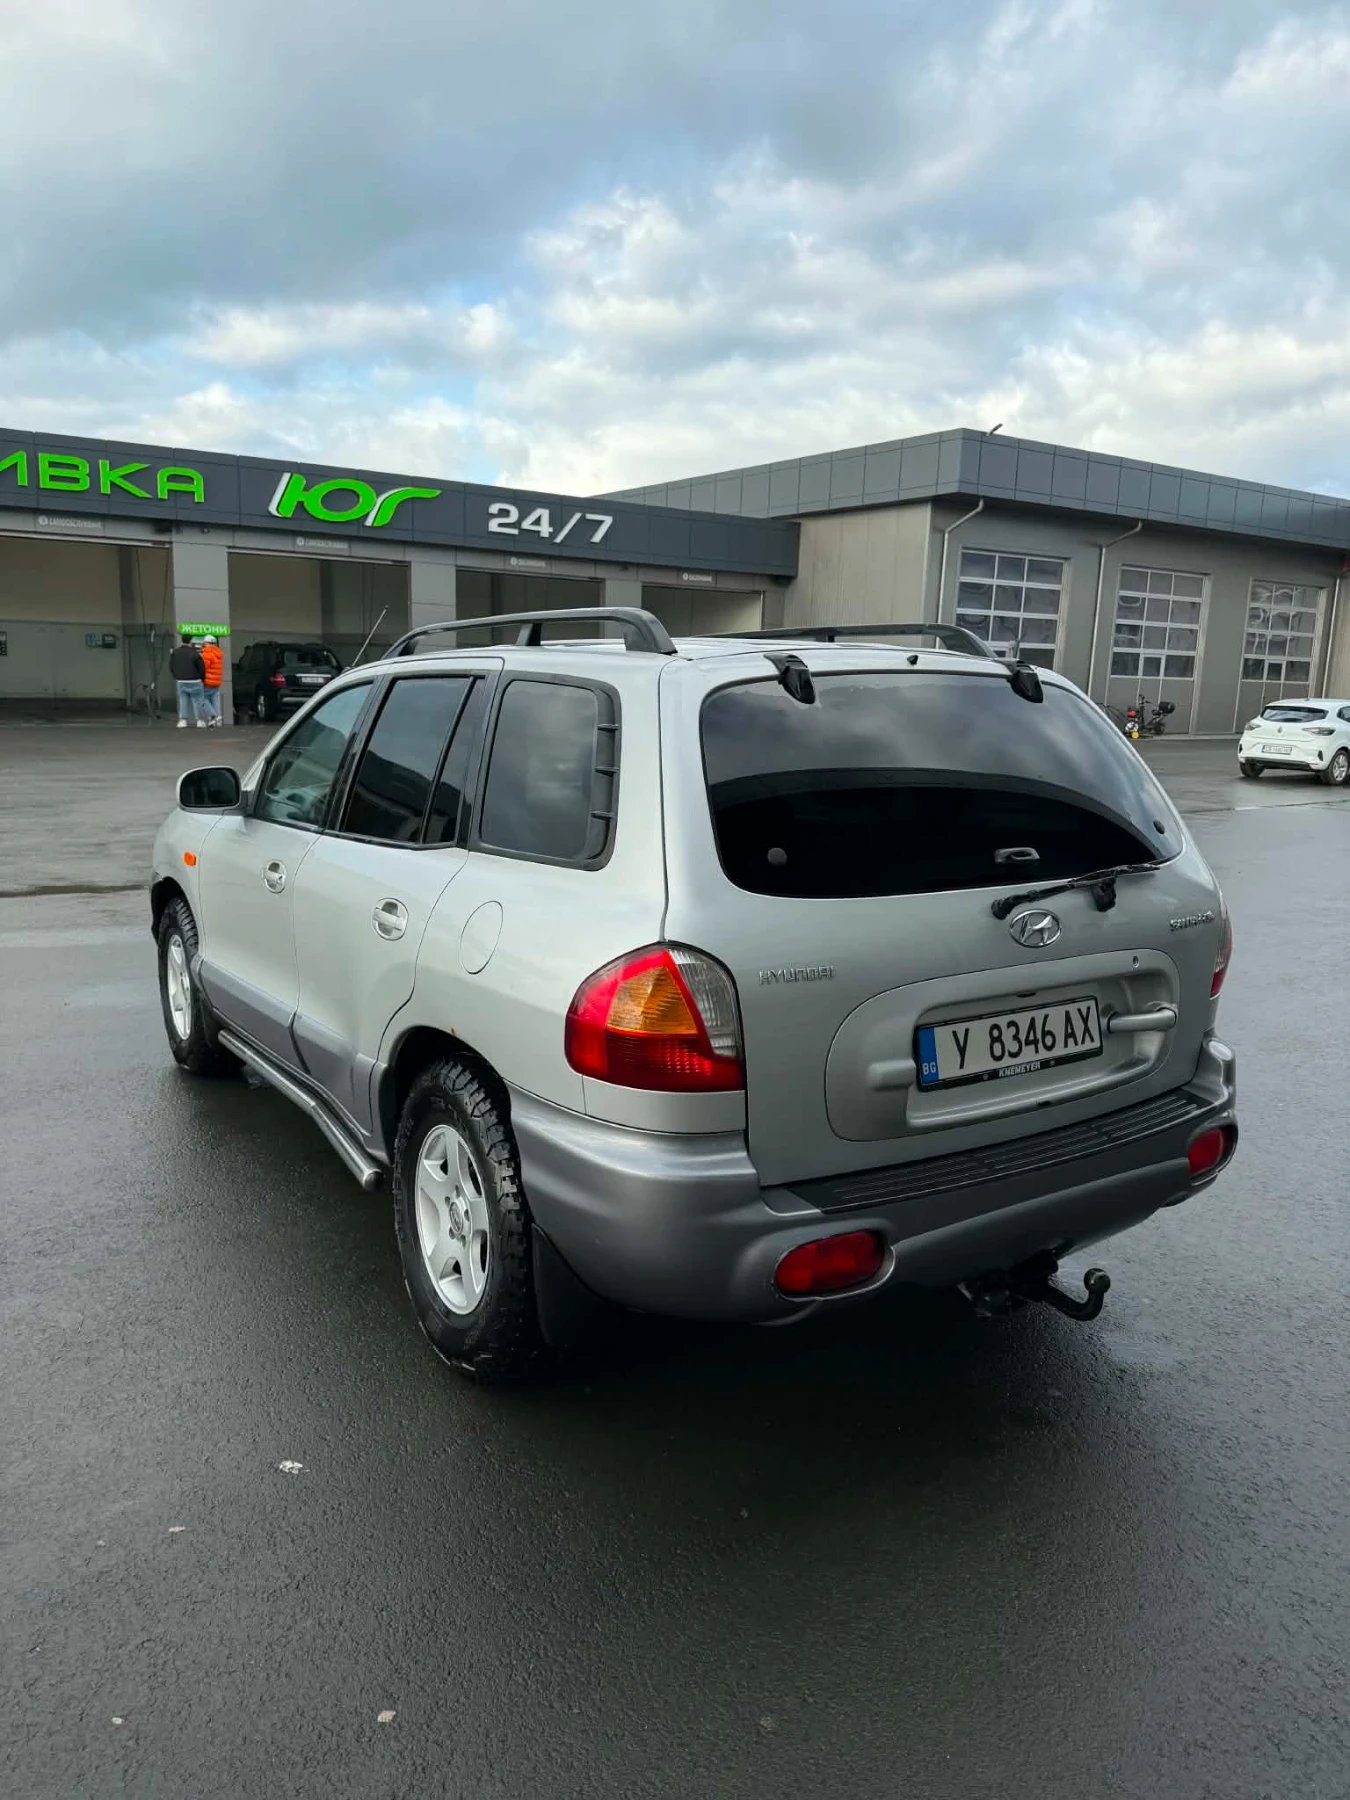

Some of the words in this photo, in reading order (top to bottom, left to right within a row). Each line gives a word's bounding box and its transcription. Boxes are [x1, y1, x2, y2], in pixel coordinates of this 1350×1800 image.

[488, 502, 613, 543] 24/7
[182, 624, 227, 634] ЖЕТОНИ
[759, 965, 834, 985] HYUNDAI
[988, 1014, 1057, 1062] 8346
[1063, 1005, 1095, 1048] AX
[922, 1061, 937, 1075] BG
